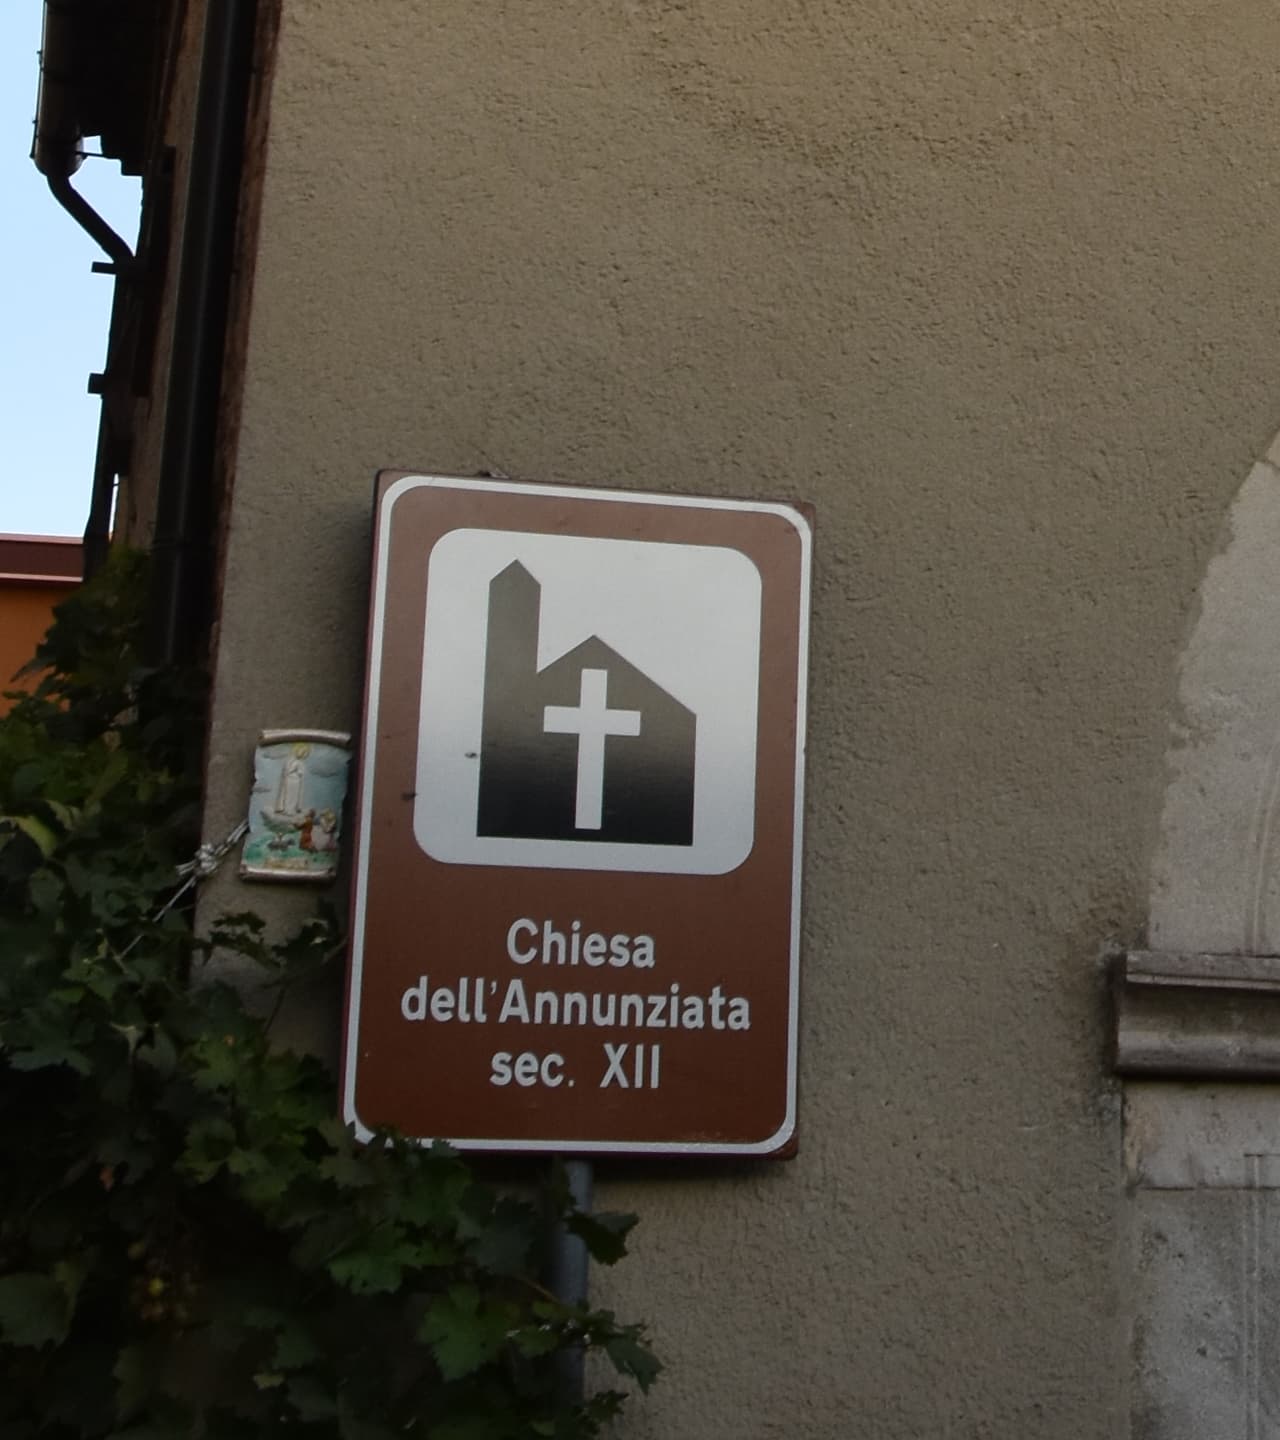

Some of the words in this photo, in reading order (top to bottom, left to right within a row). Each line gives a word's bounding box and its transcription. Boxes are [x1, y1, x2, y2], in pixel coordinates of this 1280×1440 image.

[506, 917, 656, 969] Chiesa
[401, 975, 751, 1031] dell'Annunziata
[489, 1051, 575, 1088] sec.
[599, 1043, 660, 1089] XII
